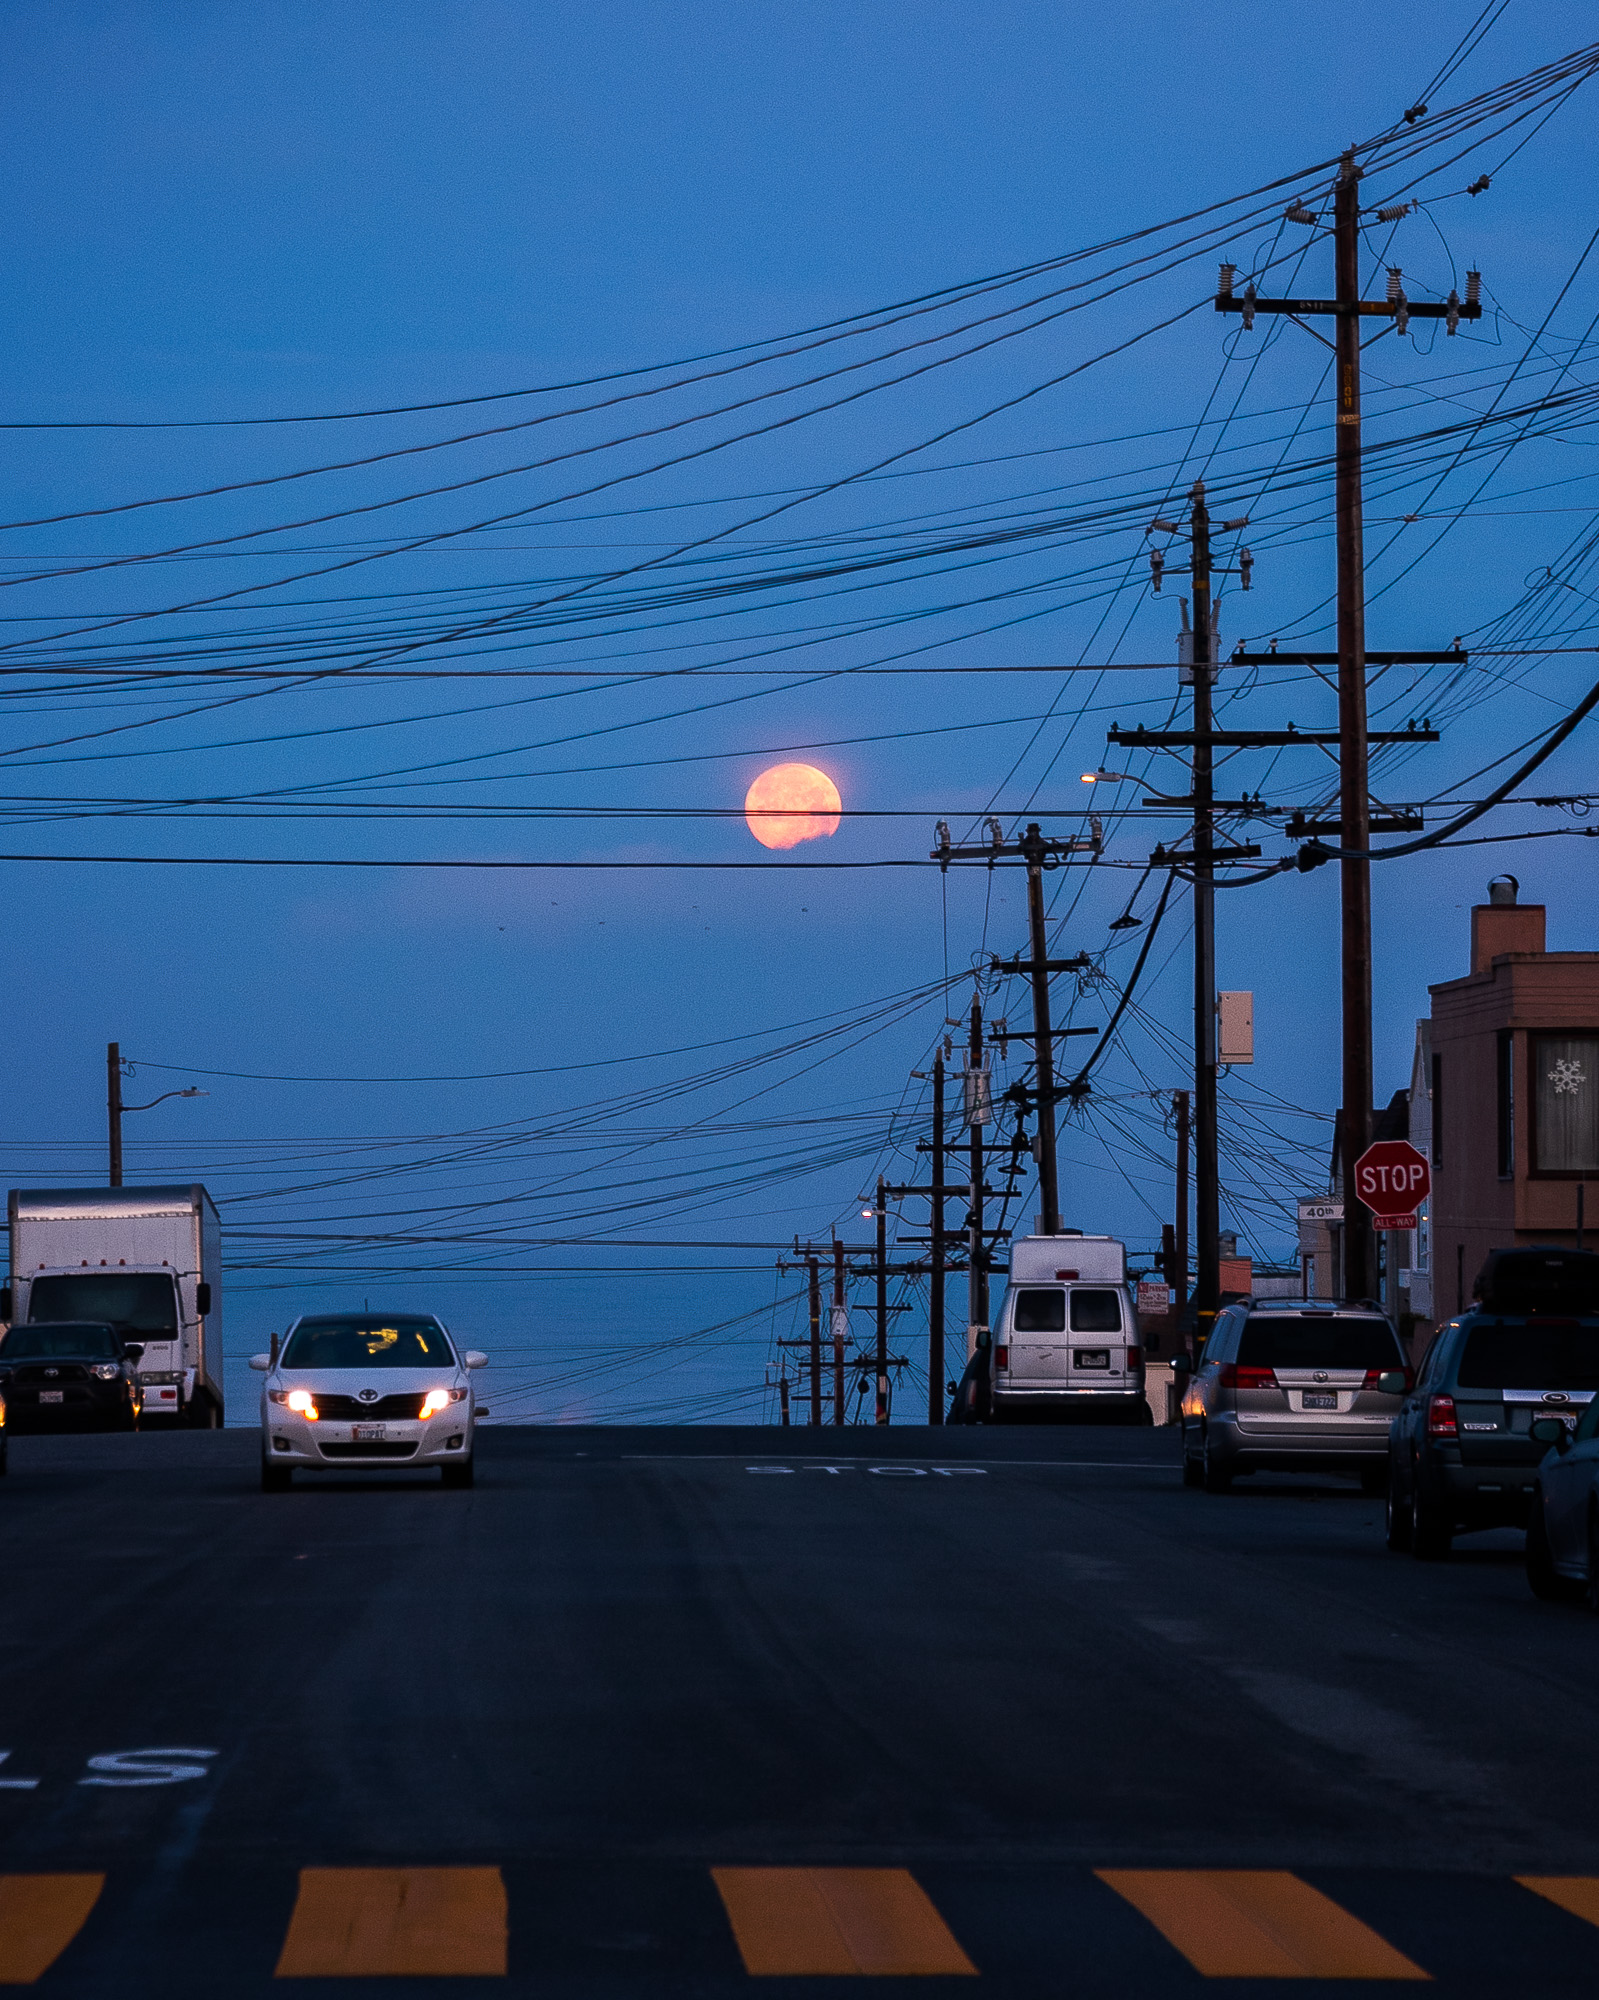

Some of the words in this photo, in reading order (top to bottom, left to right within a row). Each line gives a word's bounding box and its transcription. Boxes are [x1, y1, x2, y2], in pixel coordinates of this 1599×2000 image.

[1362, 1164, 1424, 1193] STOP
[1306, 1207, 1334, 1217] 40th
[1375, 1217, 1415, 1227] ALL-WAY
[745, 1466, 988, 1476] STOP
